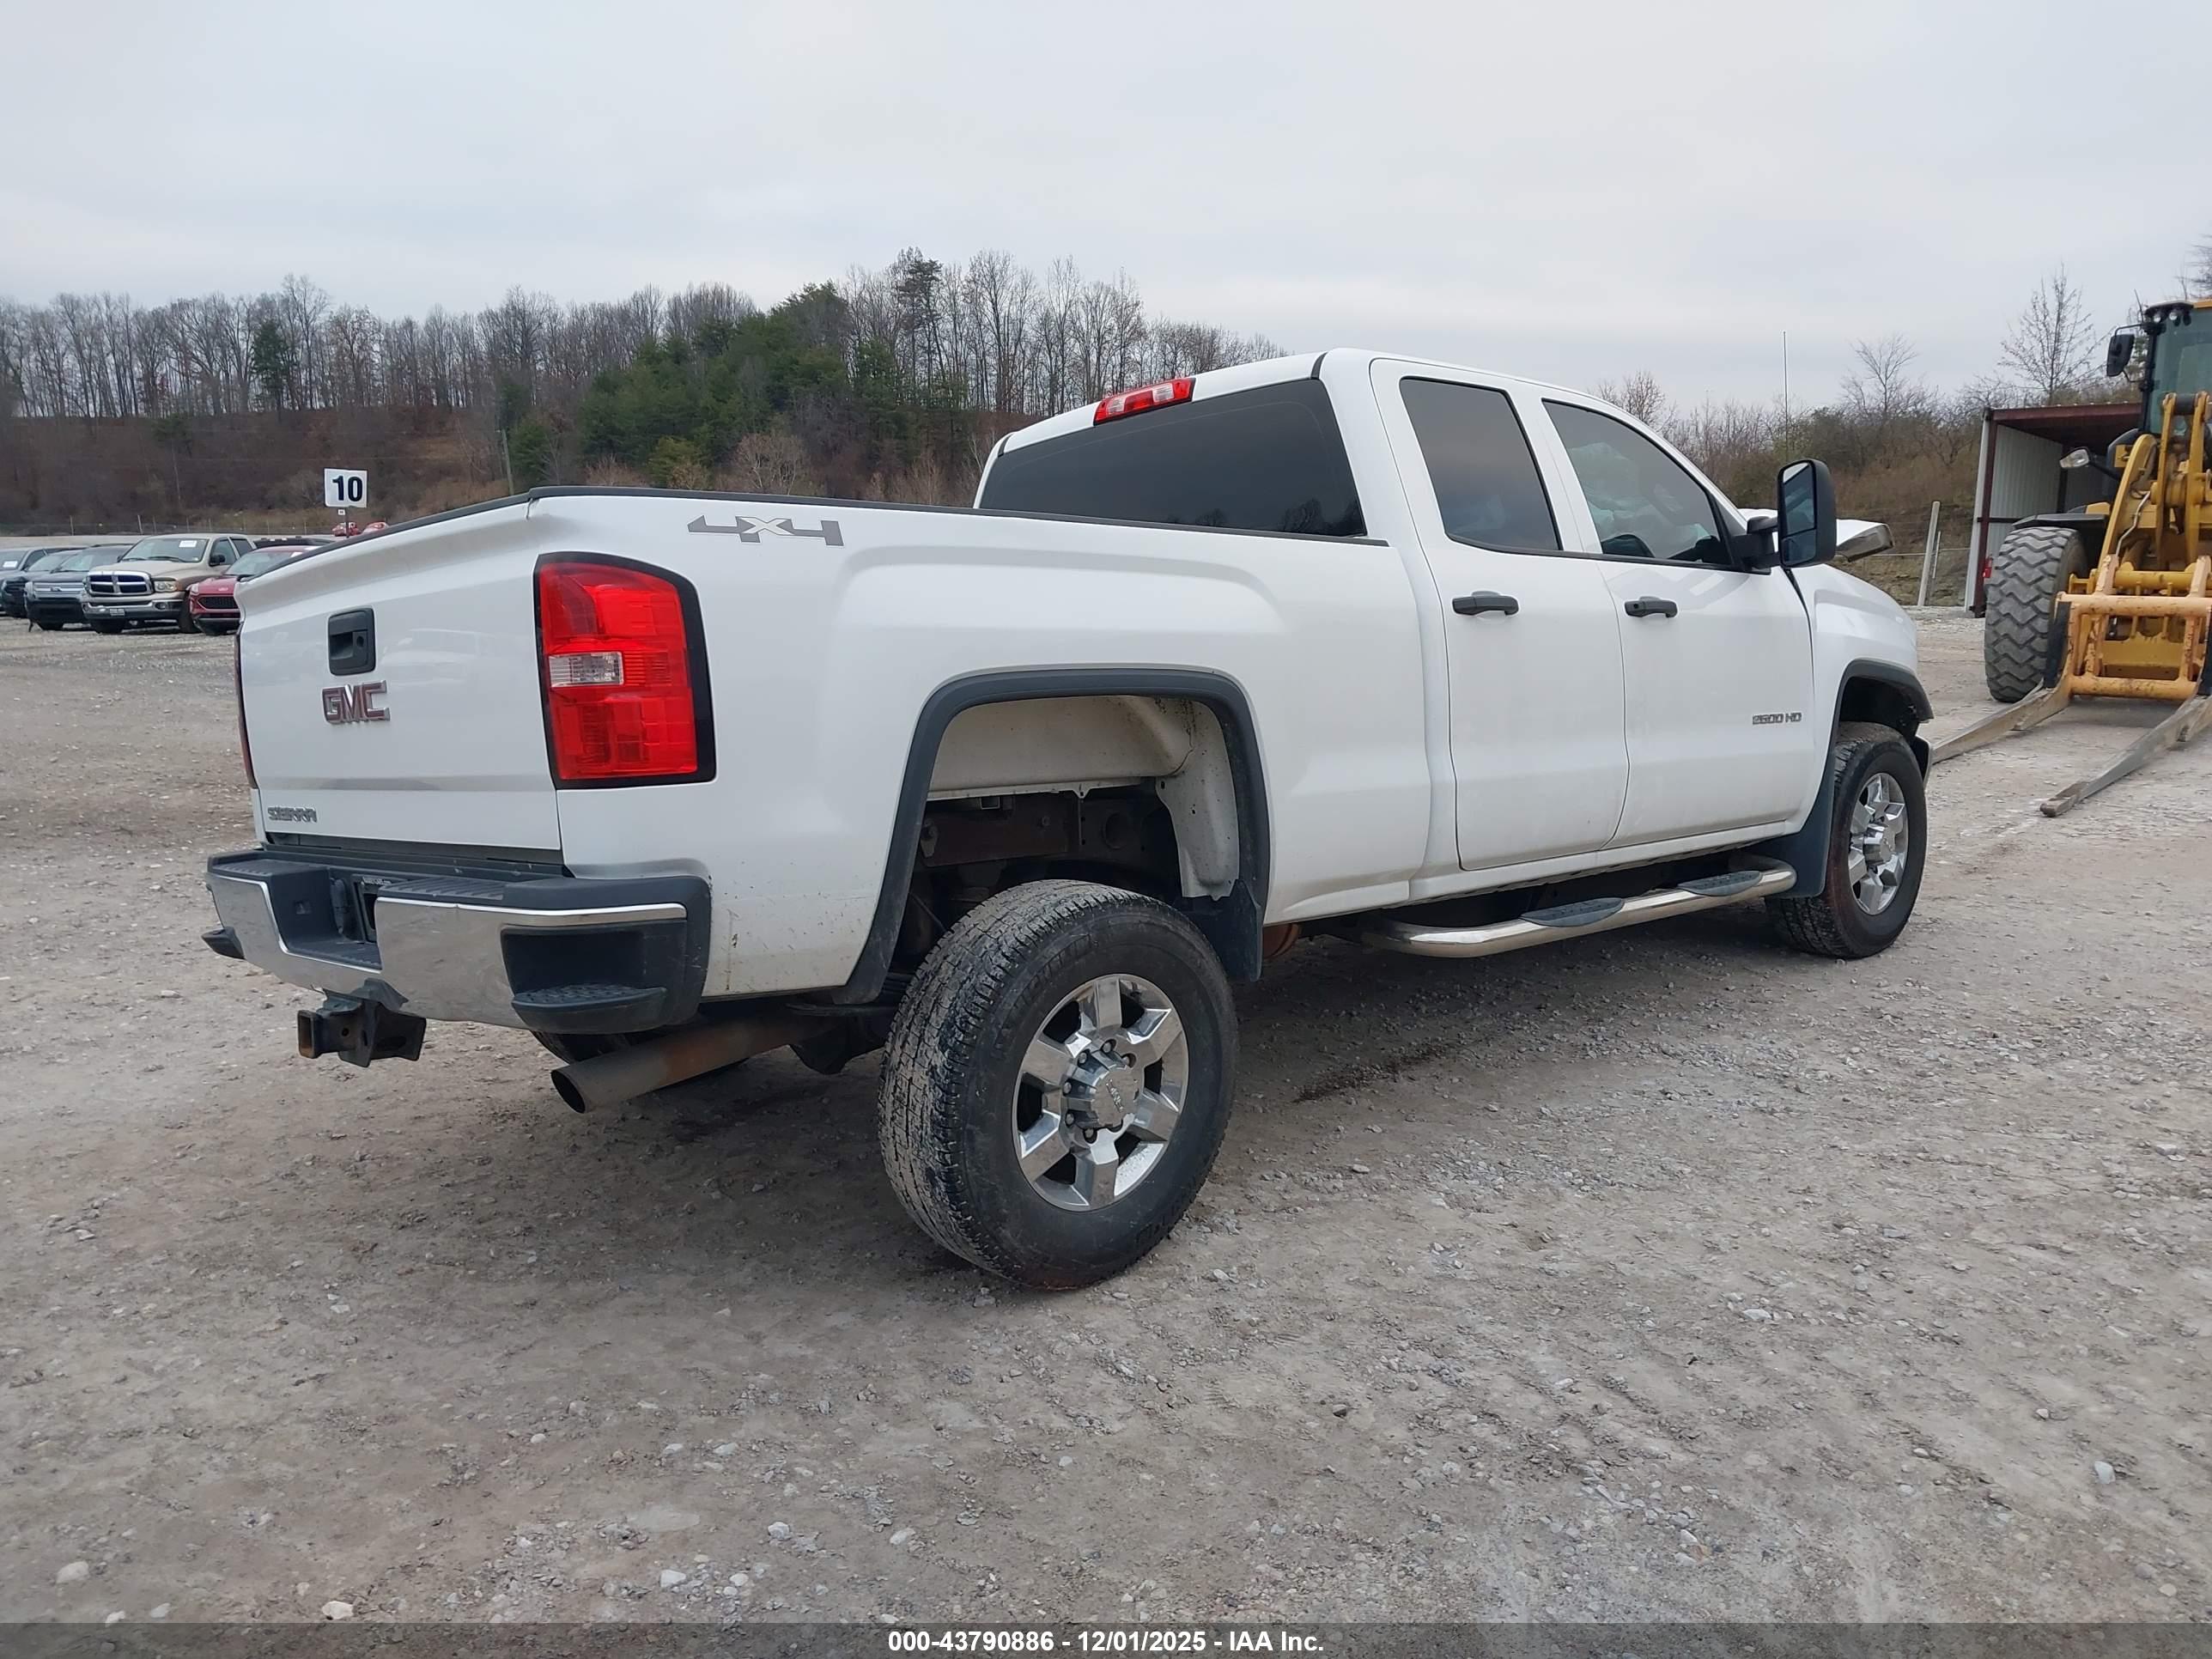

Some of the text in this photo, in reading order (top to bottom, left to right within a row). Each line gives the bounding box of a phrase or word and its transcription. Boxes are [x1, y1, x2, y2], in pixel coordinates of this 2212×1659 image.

[332, 475, 363, 502] 10
[322, 680, 390, 724] GMC
[1784, 712, 1802, 723] HD
